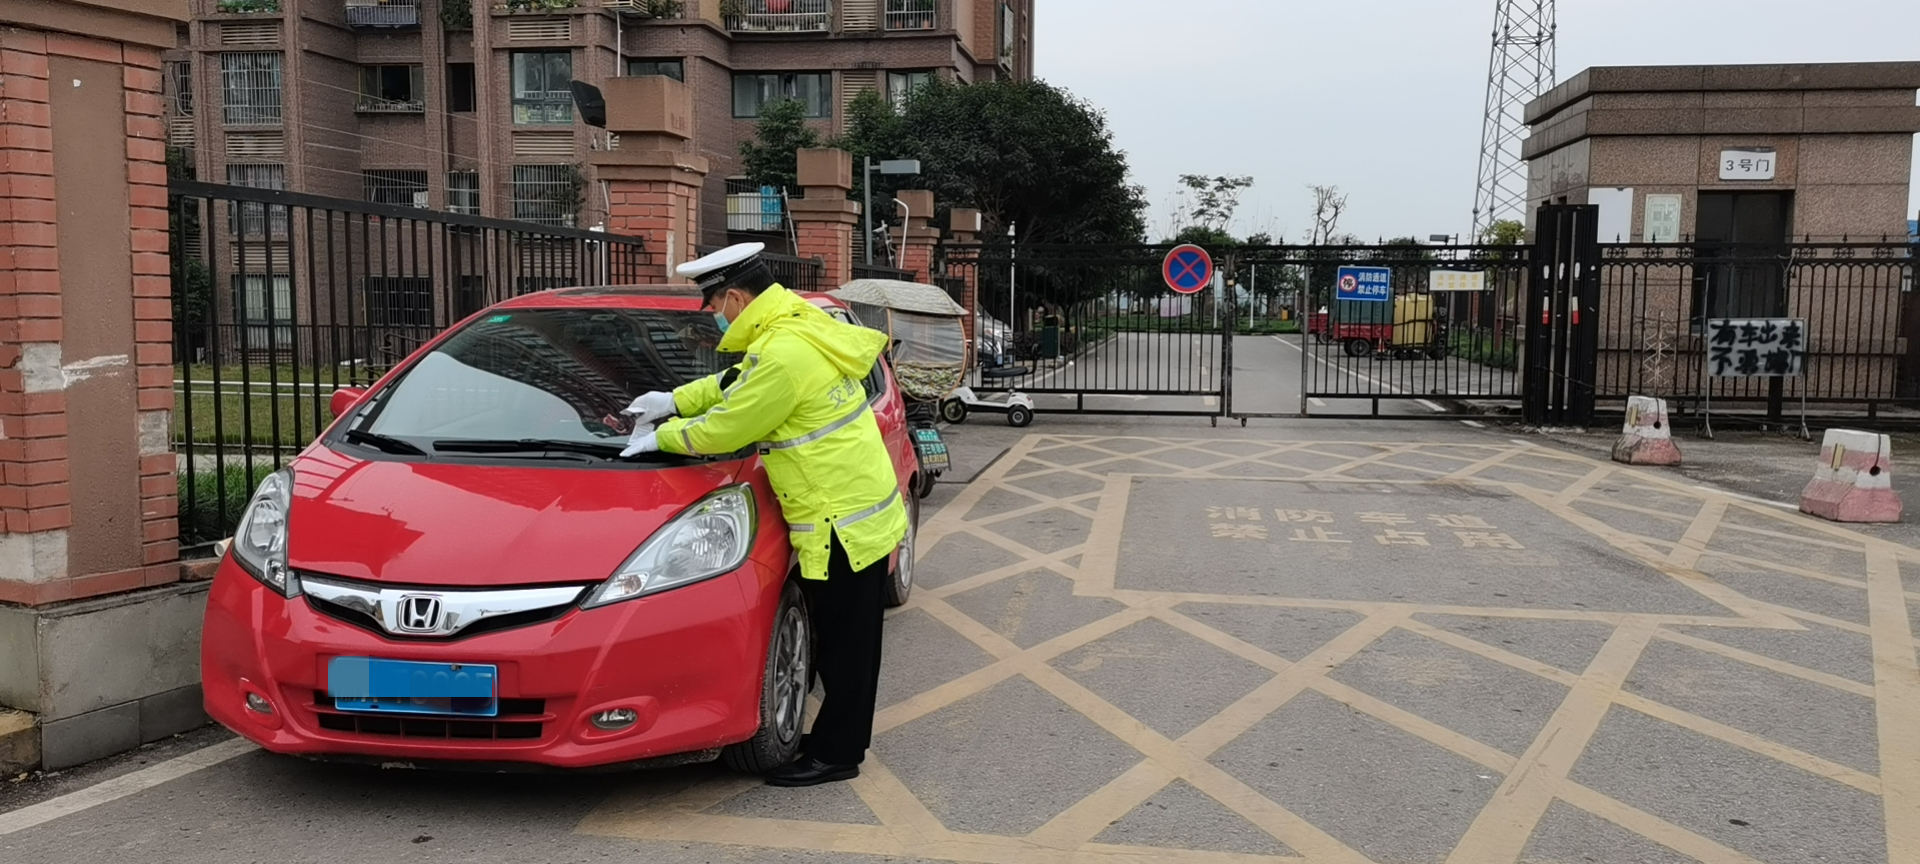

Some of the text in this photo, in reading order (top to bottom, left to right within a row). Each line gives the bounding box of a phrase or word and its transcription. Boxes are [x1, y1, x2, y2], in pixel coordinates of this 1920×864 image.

[1725, 158, 1770, 172] 3号门
[1358, 271, 1387, 282] 消防通道
[1357, 284, 1386, 295] 禁止停车
[1710, 319, 1801, 348] 有车出来
[1205, 506, 1497, 529] 消防车道
[1209, 523, 1526, 549] 禁止占用
